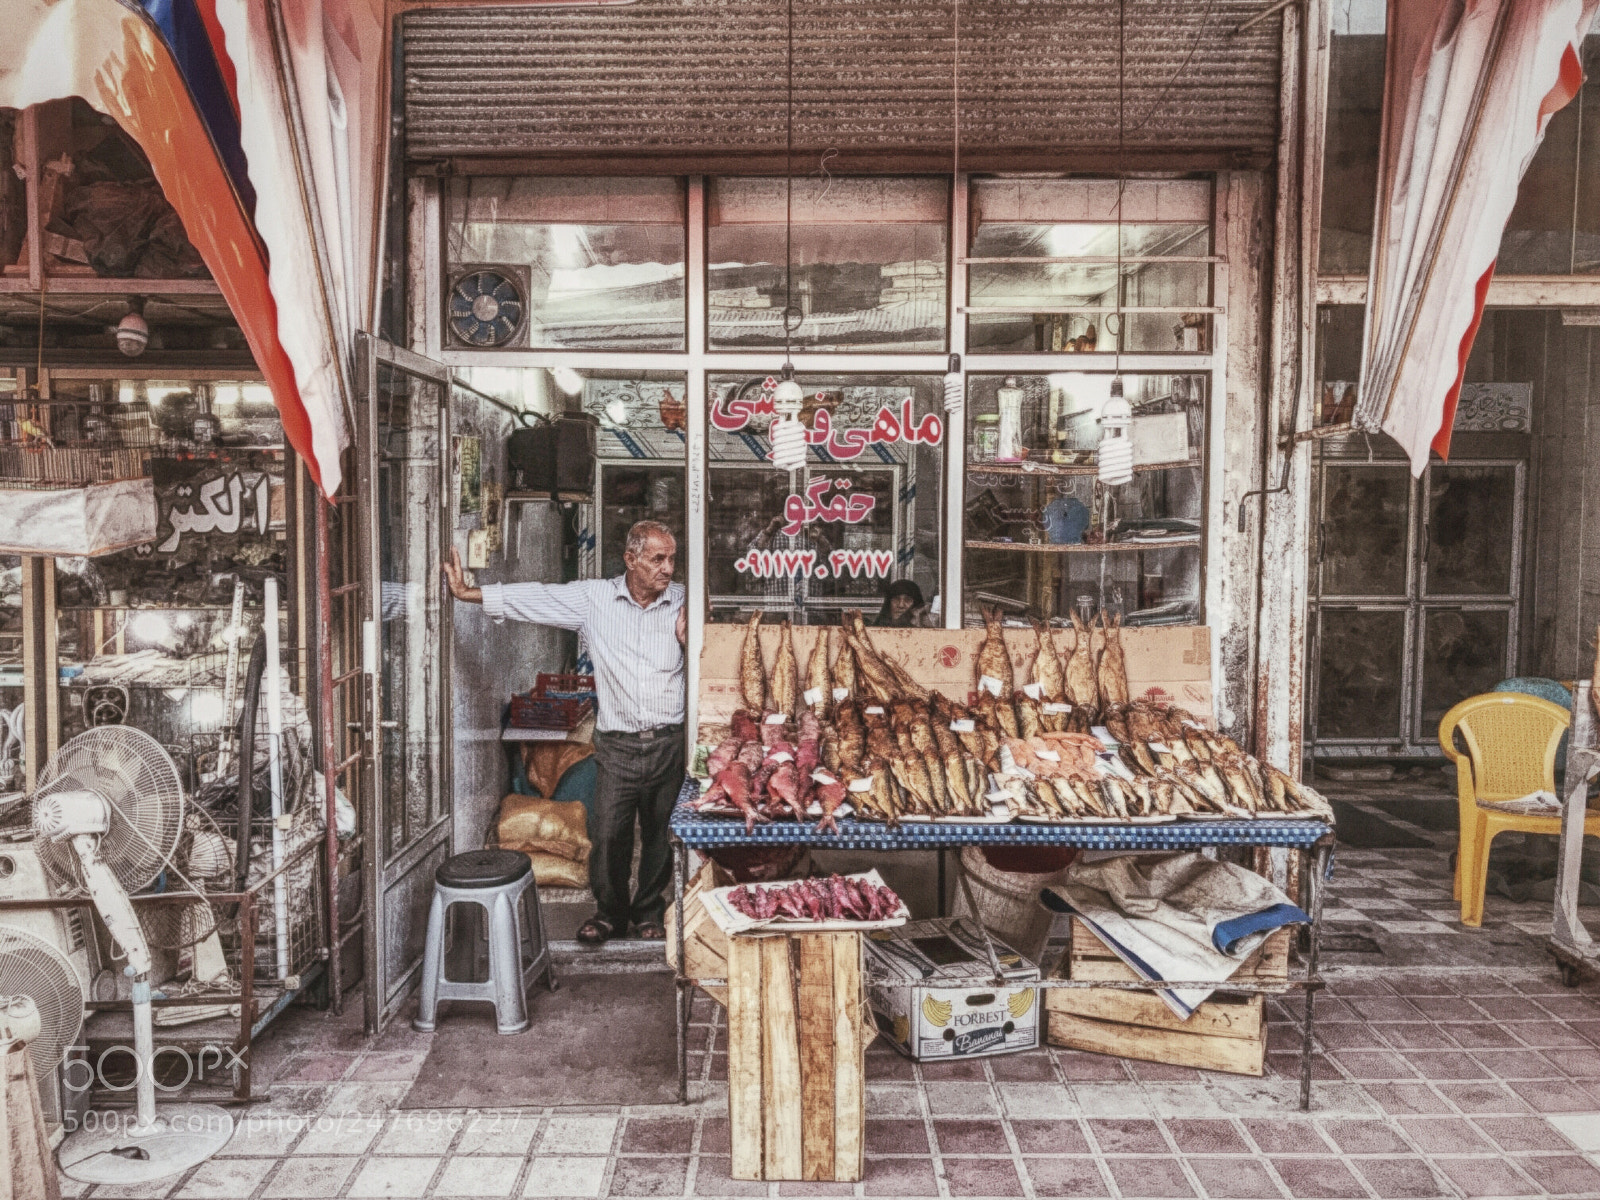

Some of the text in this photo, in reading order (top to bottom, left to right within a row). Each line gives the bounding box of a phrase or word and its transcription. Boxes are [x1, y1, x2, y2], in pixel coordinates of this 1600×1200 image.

[709, 375, 832, 461] فشی
[132, 473, 269, 553] الکتر
[781, 475, 876, 536] حقگو
[954, 1010, 1007, 1027] FORBEST
[956, 1030, 1003, 1052] Bananas
